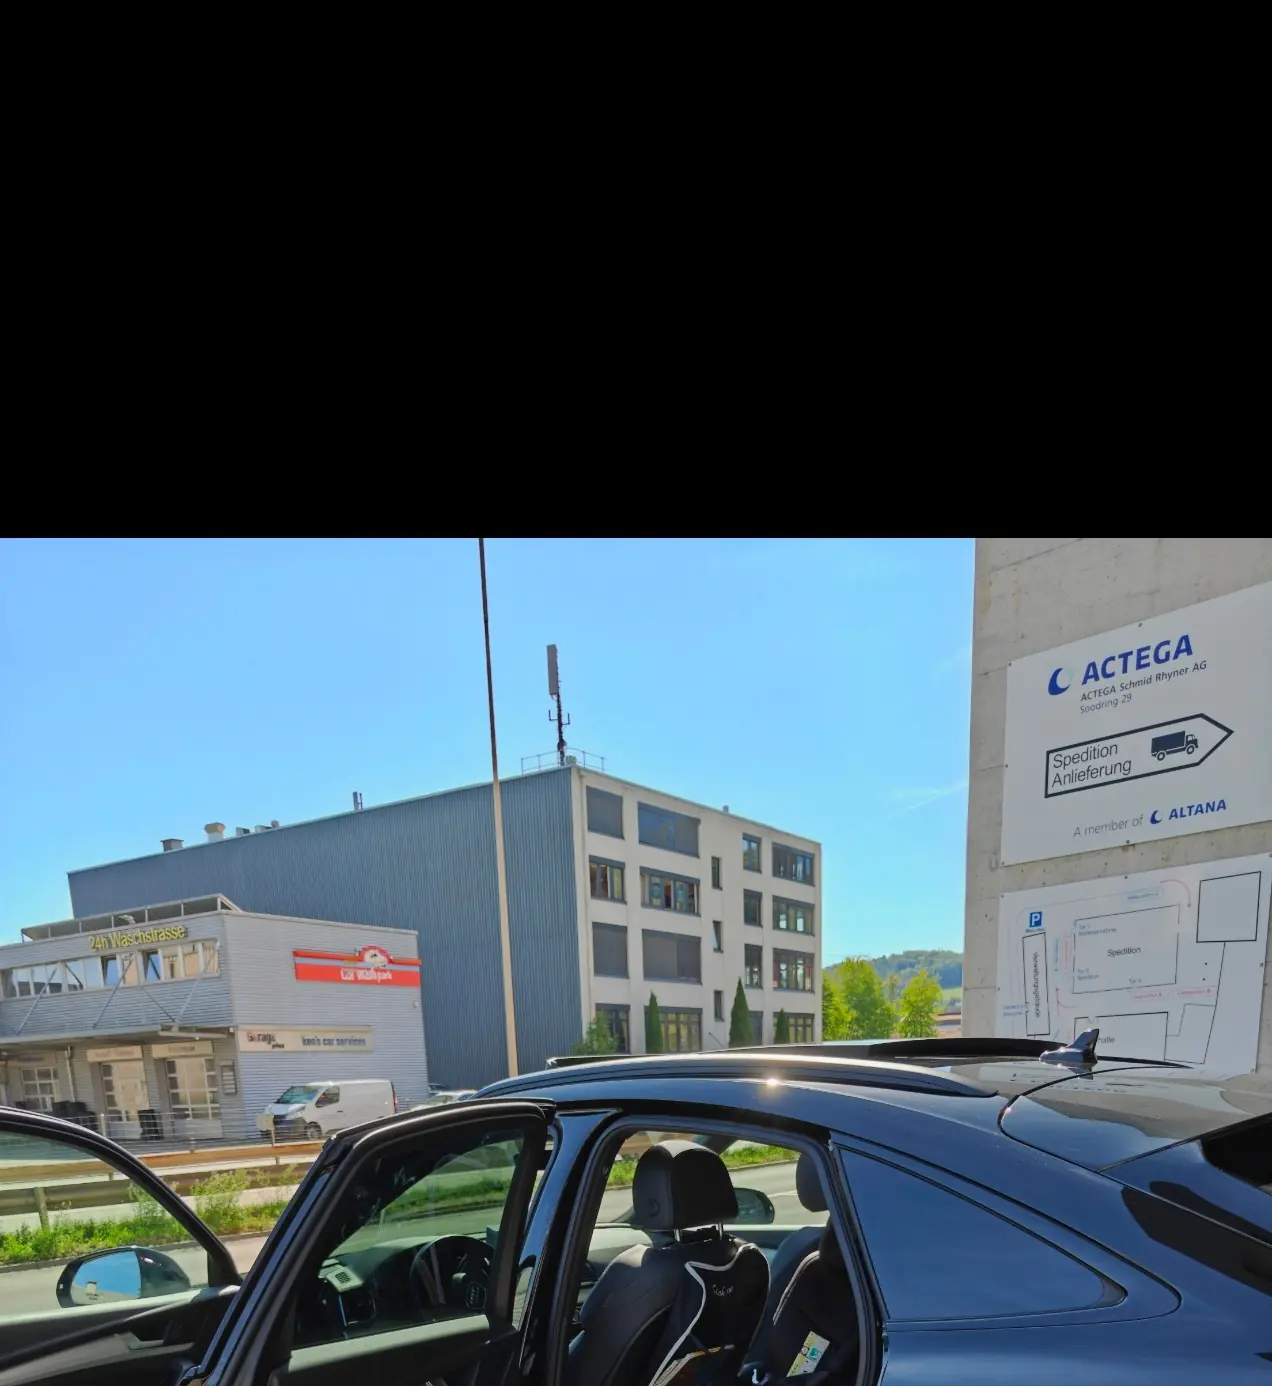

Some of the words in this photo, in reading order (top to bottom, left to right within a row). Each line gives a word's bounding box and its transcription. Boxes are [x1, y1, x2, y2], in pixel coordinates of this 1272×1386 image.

[1081, 634, 1193, 685] ACTEGA
[1080, 685, 1116, 702] ACTEGA
[1119, 675, 1152, 692] Schmid
[1155, 667, 1189, 683] Rhyner
[1192, 660, 1207, 673] AG
[1080, 698, 1119, 714] Soodring
[1121, 693, 1132, 704] 29
[1053, 744, 1118, 770] Spedition
[1052, 760, 1132, 788] Anlieferung
[1073, 826, 1081, 838] A
[1084, 819, 1129, 836] member
[1132, 814, 1144, 827] of
[1168, 799, 1227, 820] ALTANA
[88, 934, 109, 952] 24h
[109, 925, 185, 949] Waschstrasse
[1107, 946, 1142, 958] Spedition
